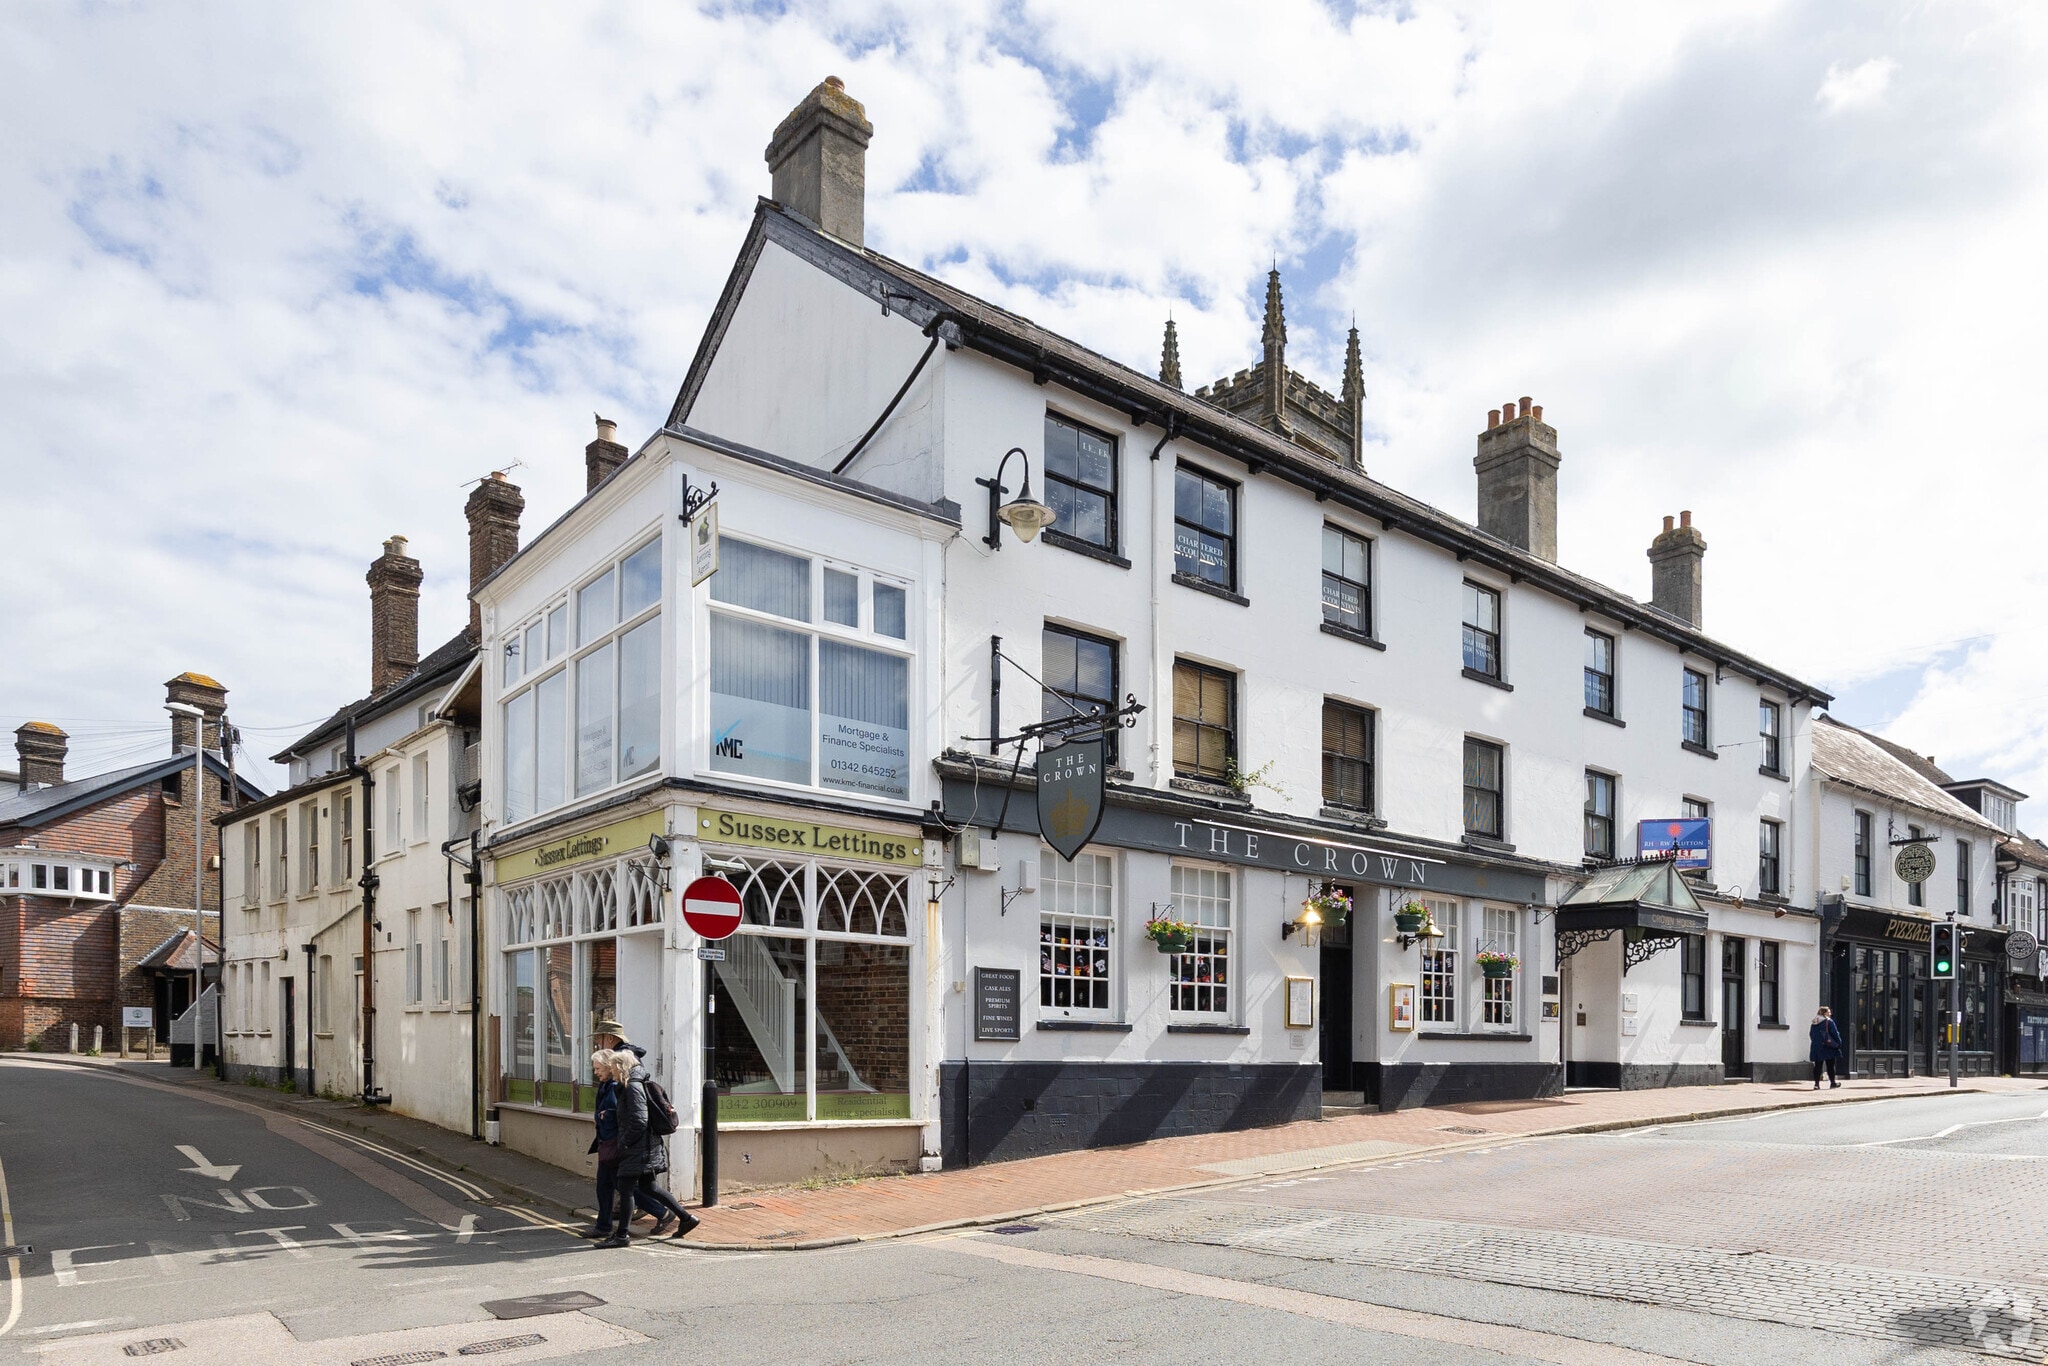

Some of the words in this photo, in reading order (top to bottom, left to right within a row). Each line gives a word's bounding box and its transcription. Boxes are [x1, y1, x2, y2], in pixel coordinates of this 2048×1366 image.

[1178, 535, 1223, 557] CHARTERED
[838, 724, 880, 741] Mortgage
[881, 732, 889, 742] &
[715, 730, 743, 759] KMC
[822, 734, 857, 749] Finance
[859, 741, 905, 757] Specialists
[831, 759, 860, 773] 01342
[861, 764, 897, 779] 645252
[1056, 753, 1085, 768] THE
[1043, 763, 1097, 783] CROWN
[822, 776, 904, 795] www.kmc-financial.co.uk
[719, 813, 806, 846] Sussex
[812, 826, 907, 860] Lettings
[537, 848, 565, 867] Sussex
[566, 836, 602, 859] Lettings
[1174, 822, 1259, 859] THE
[1294, 842, 1426, 884] CROWN
[719, 1099, 749, 1110] 1342
[753, 1098, 797, 1110] 300909
[837, 1095, 887, 1105] Residential
[823, 1108, 853, 1119] letting
[855, 1107, 901, 1118] specialists
[160, 1186, 318, 1222] NO
